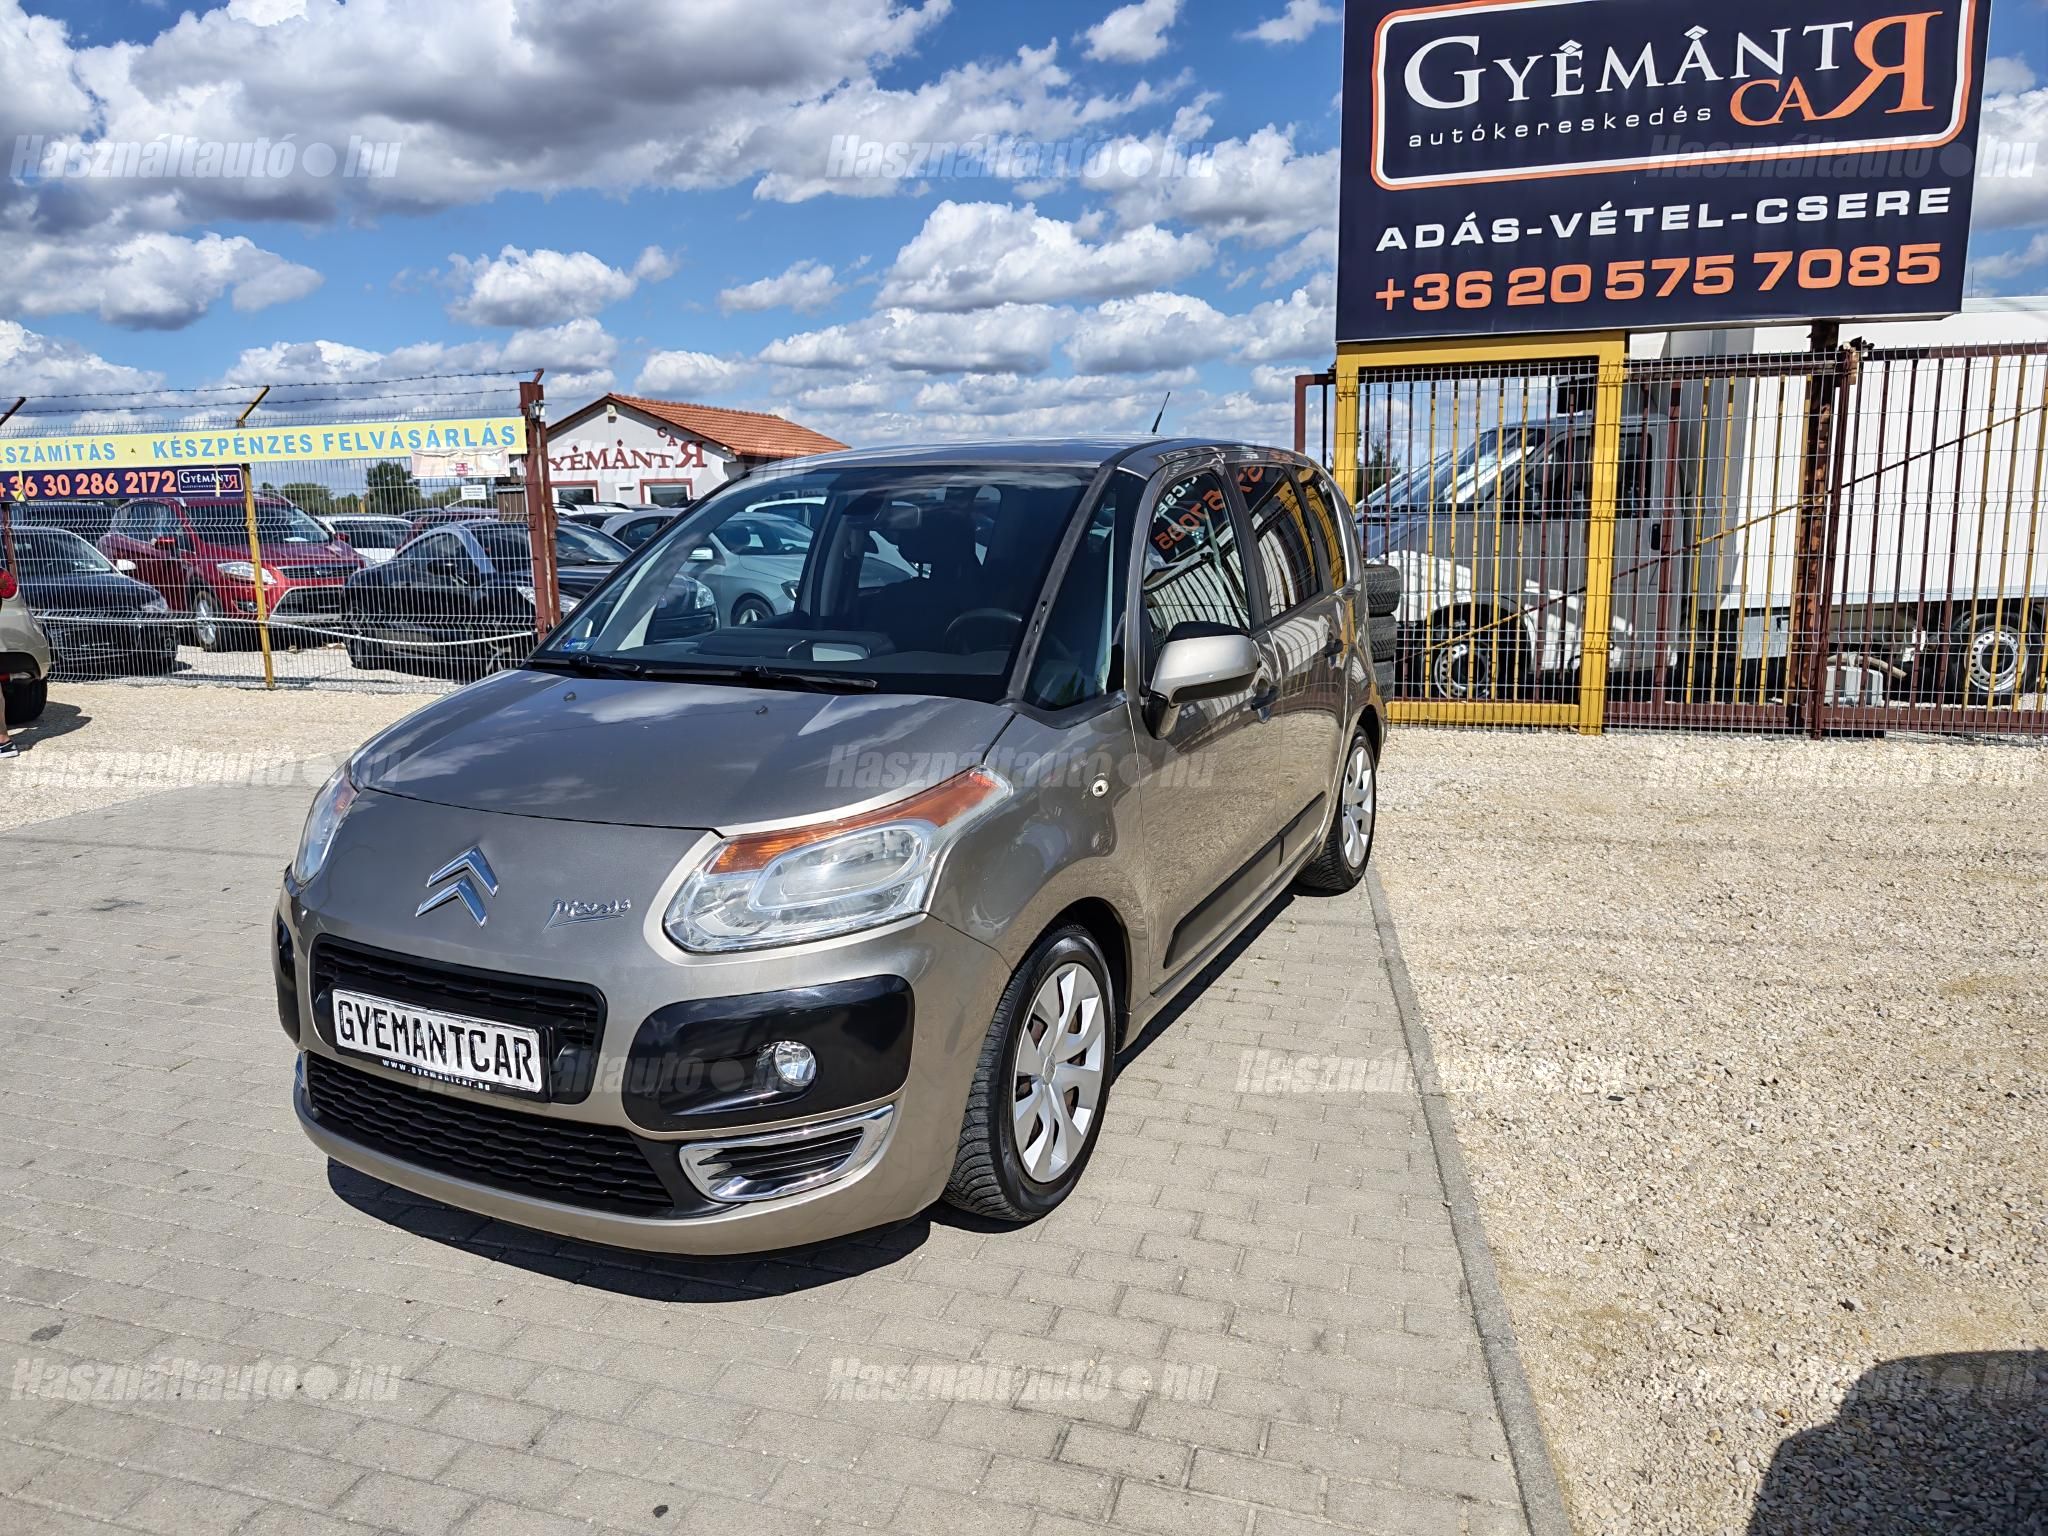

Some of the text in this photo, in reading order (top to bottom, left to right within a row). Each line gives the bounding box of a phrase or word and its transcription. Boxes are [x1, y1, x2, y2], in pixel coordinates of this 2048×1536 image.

[1408, 104, 1712, 148] autókereskedés
[1376, 187, 1952, 252] ADÁS-VÉTEL-CSERE
[1375, 242, 1942, 312] +36 20 575 7085
[0, 421, 516, 465] SZÁMÍTÁS KÉSZPÉNZES FELVÁSÁRLÁS
[43, 473, 71, 497] 30
[75, 471, 119, 496] 286
[125, 470, 177, 495] 2172
[338, 999, 535, 1083] GYEMANTCAR
